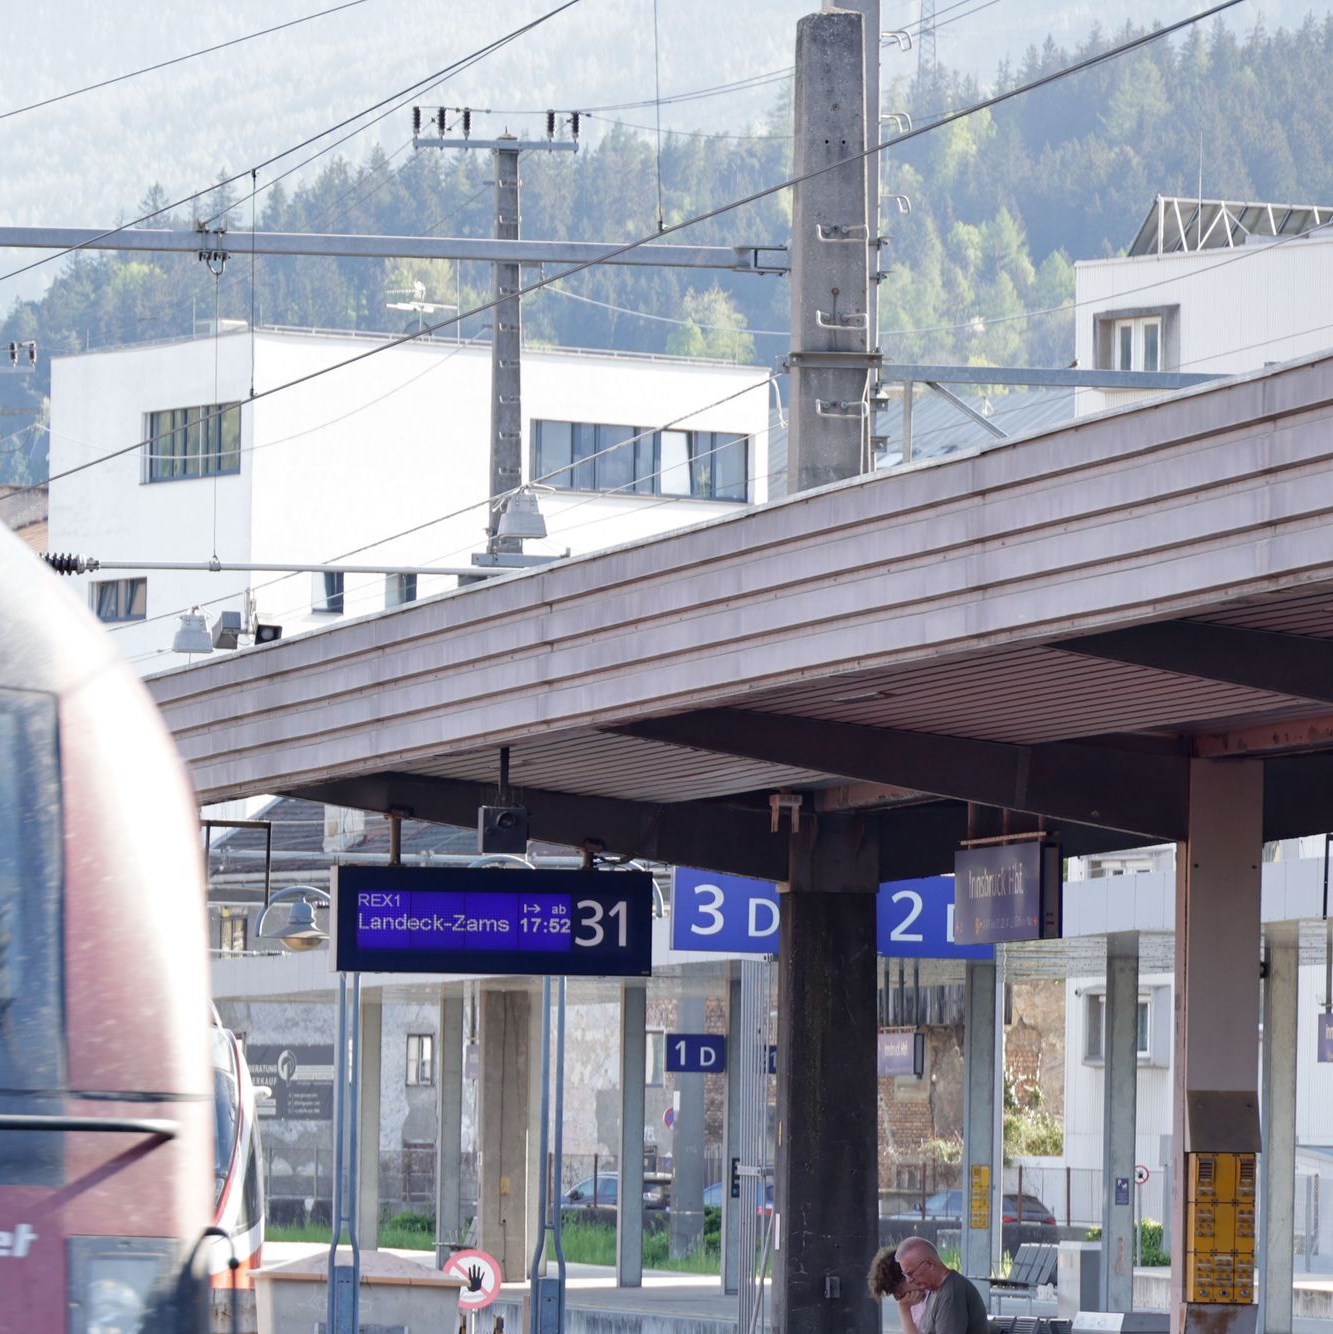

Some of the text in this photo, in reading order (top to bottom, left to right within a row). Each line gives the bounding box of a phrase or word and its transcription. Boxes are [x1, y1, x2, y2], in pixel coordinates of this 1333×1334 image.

[357, 893, 401, 908] REX1
[551, 904, 567, 915] ab
[690, 884, 780, 937] 3 D
[358, 914, 571, 934] Landeck-Zams 17:52
[575, 900, 628, 947] 31
[890, 890, 924, 942] 2
[675, 1040, 716, 1067] 1 D
[253, 1077, 277, 1086] ERKAUF
